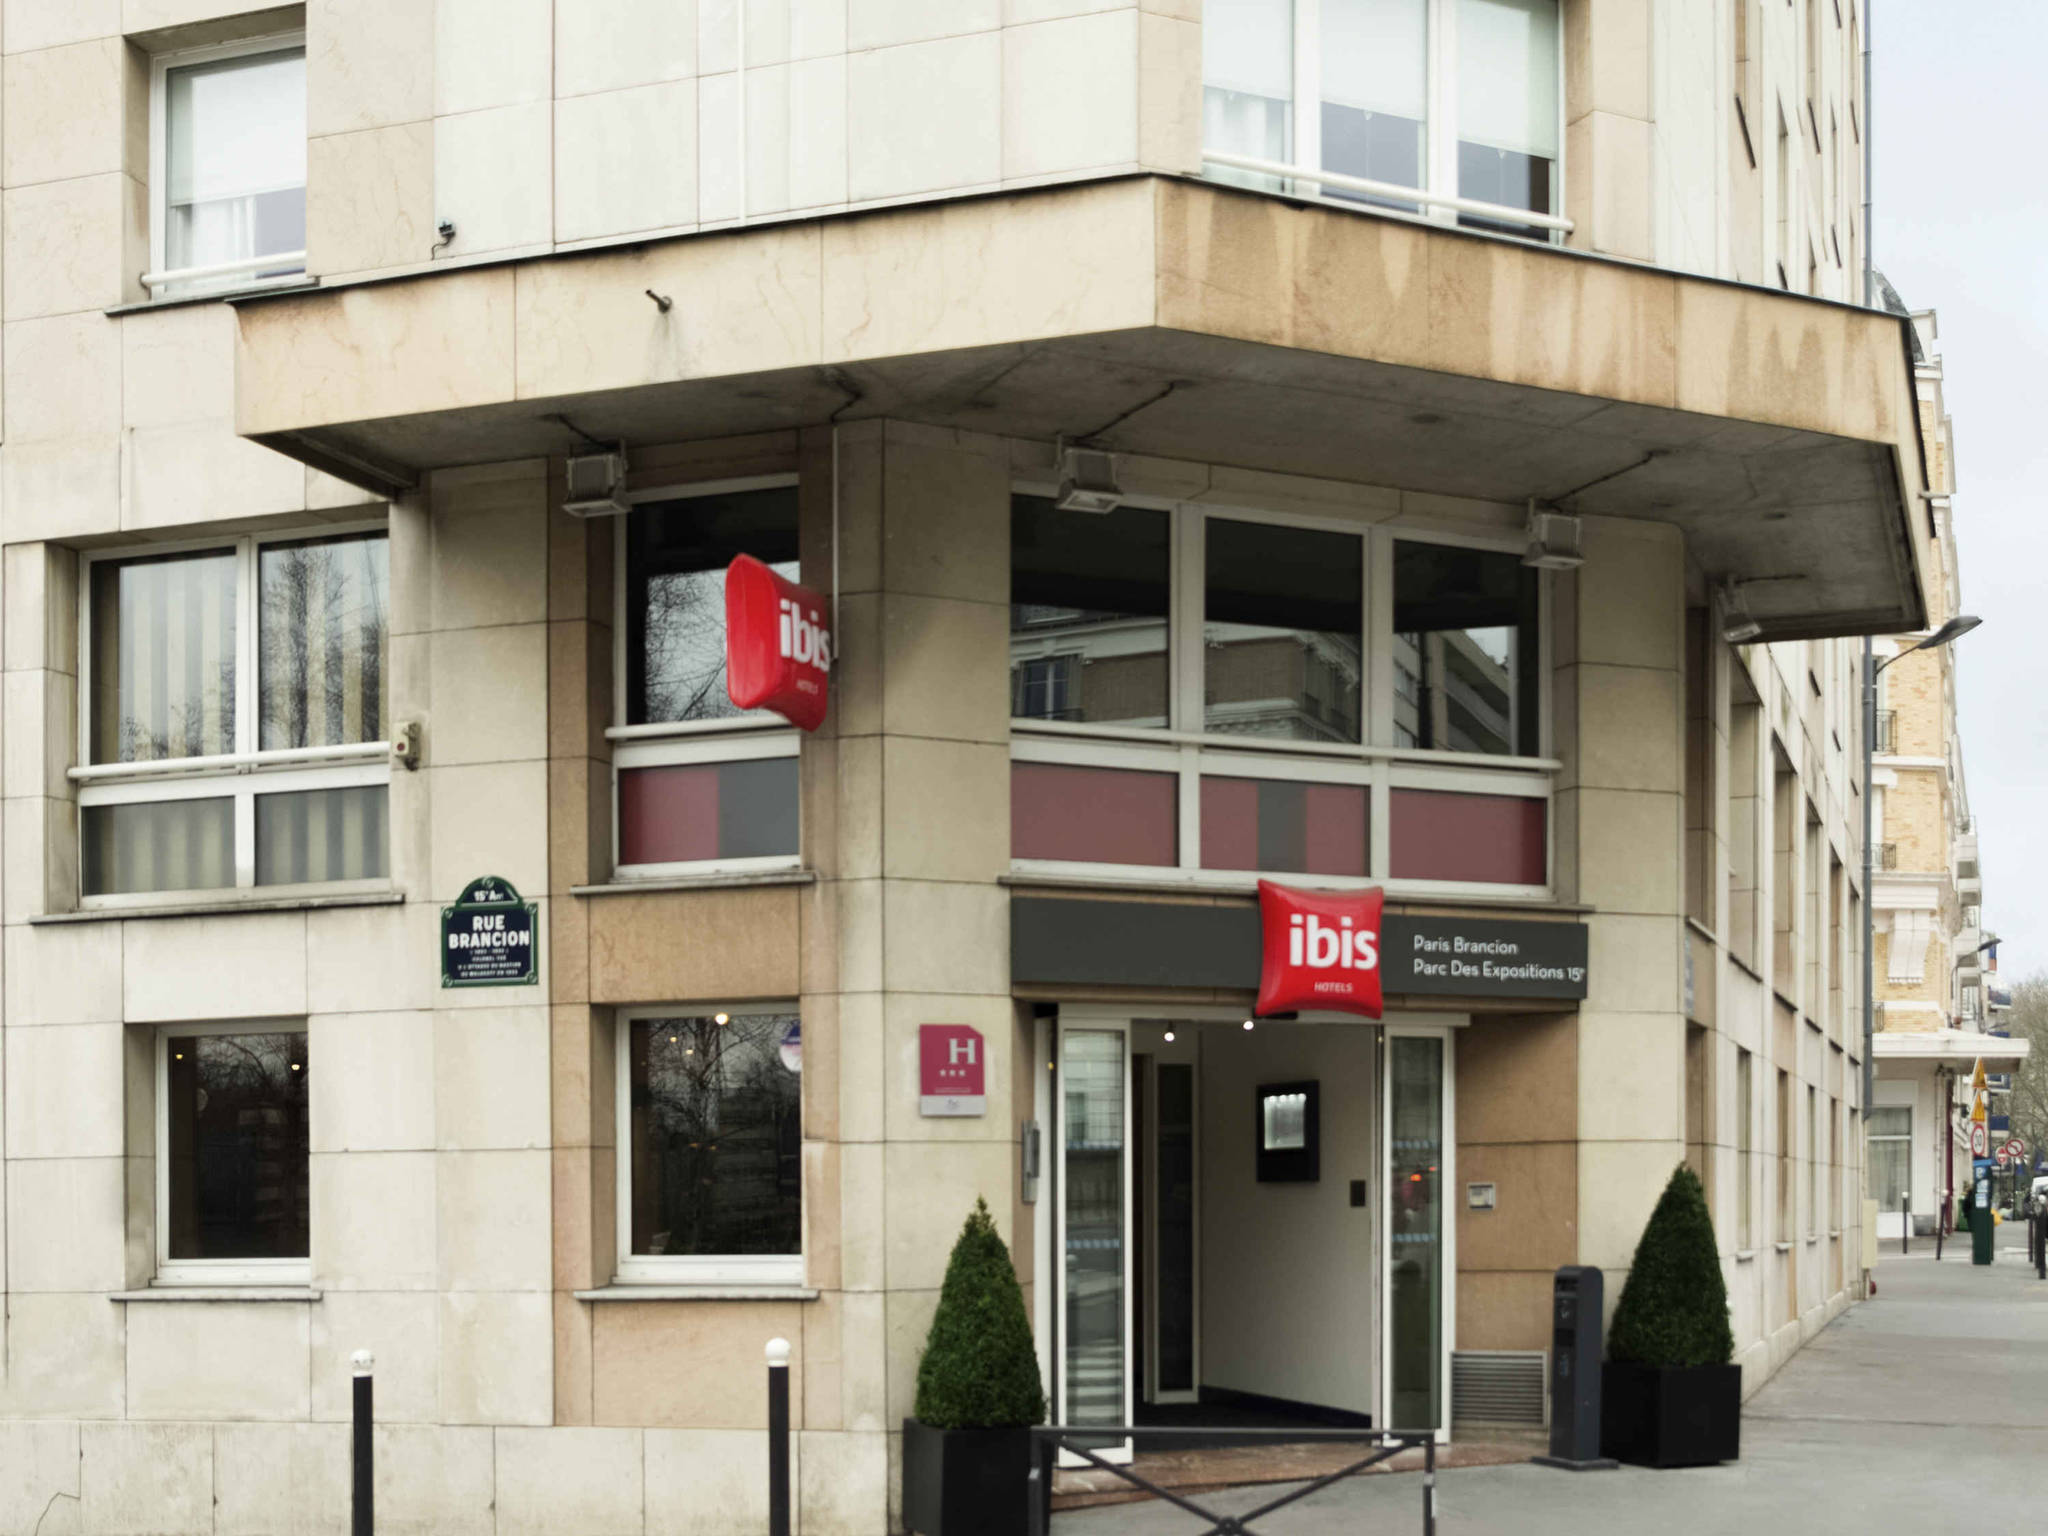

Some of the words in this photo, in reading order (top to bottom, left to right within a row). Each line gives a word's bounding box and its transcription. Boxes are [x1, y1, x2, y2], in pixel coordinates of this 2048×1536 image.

[780, 598, 830, 672] ibis
[472, 914, 505, 931] RUE
[448, 930, 530, 949] BRANCION
[1289, 913, 1378, 970] ibis
[1413, 934, 1450, 952] Paris
[1453, 936, 1518, 955] Brancion
[1413, 958, 1447, 975] Parc
[1451, 960, 1479, 977] Des
[1482, 961, 1564, 980] Expositions
[1314, 982, 1353, 993] HOTELS
[949, 1038, 976, 1064] H
